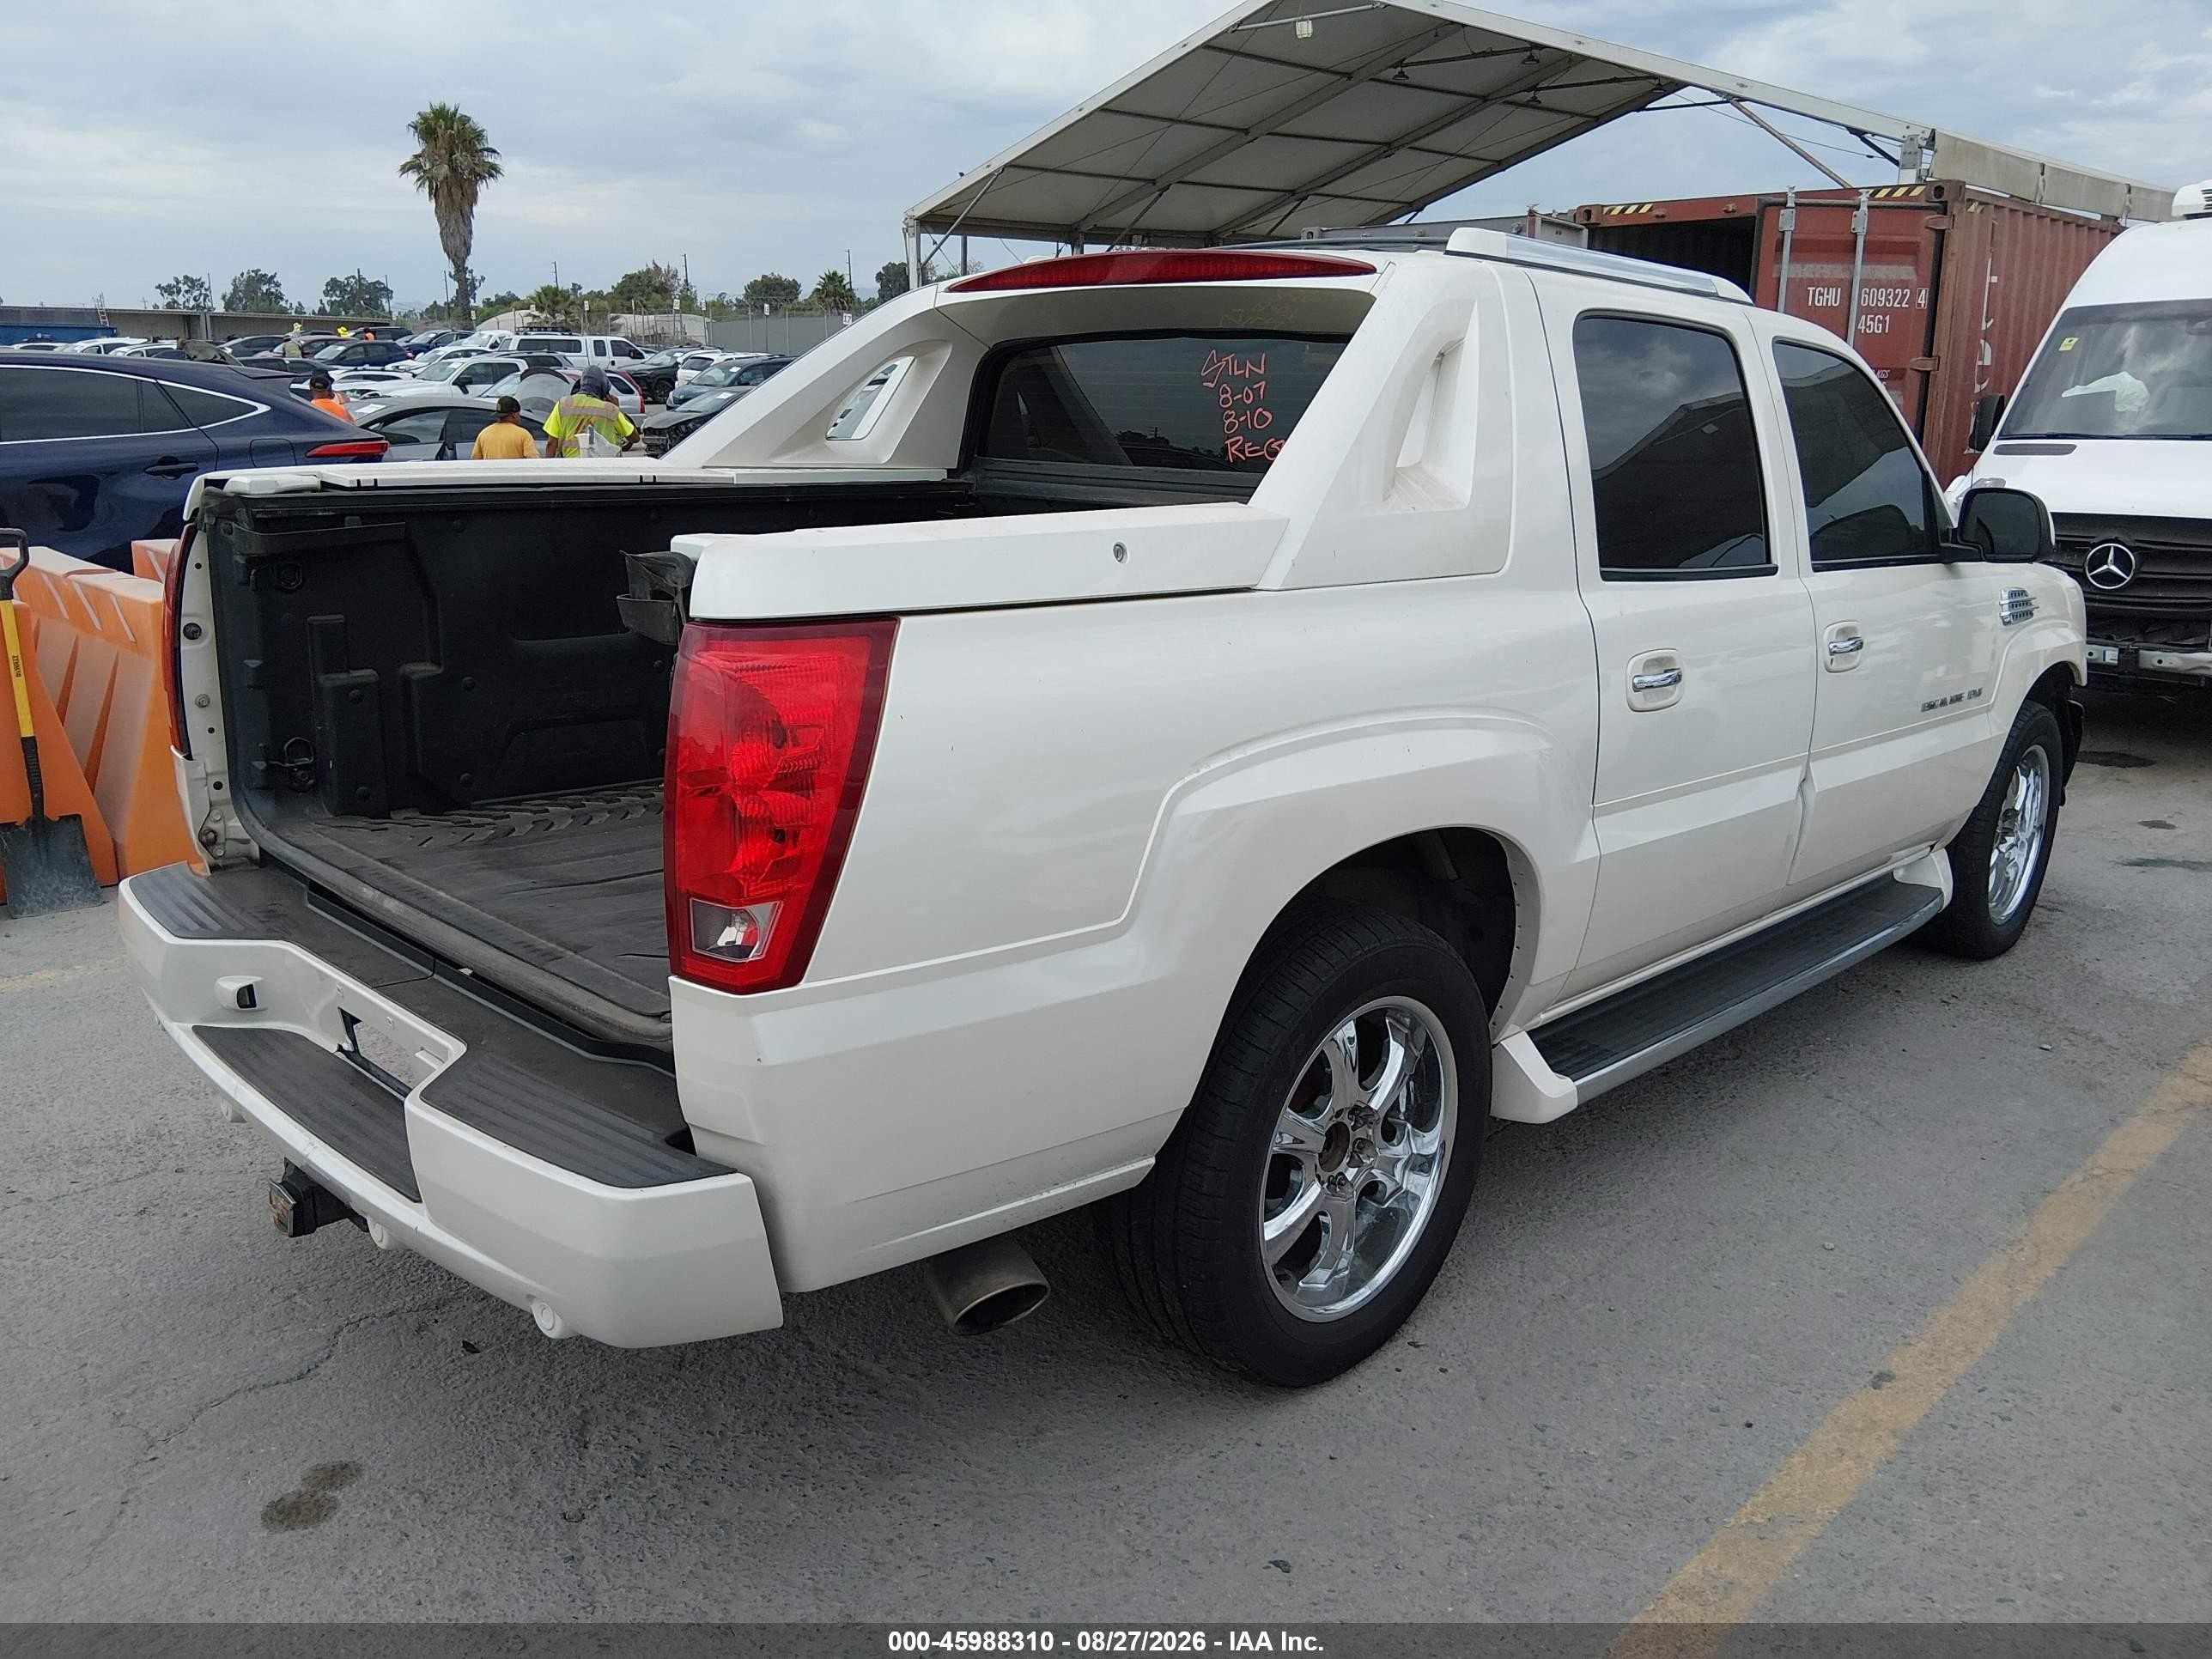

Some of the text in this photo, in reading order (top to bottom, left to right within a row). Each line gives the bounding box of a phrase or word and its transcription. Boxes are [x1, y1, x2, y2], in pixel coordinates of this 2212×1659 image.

[1808, 287, 1927, 308] TGHU 609322 4
[1857, 314, 1890, 334] 45G1
[1200, 349, 1267, 388] STLN
[1218, 380, 1266, 408] 8-07
[1222, 407, 1273, 434] 8-10
